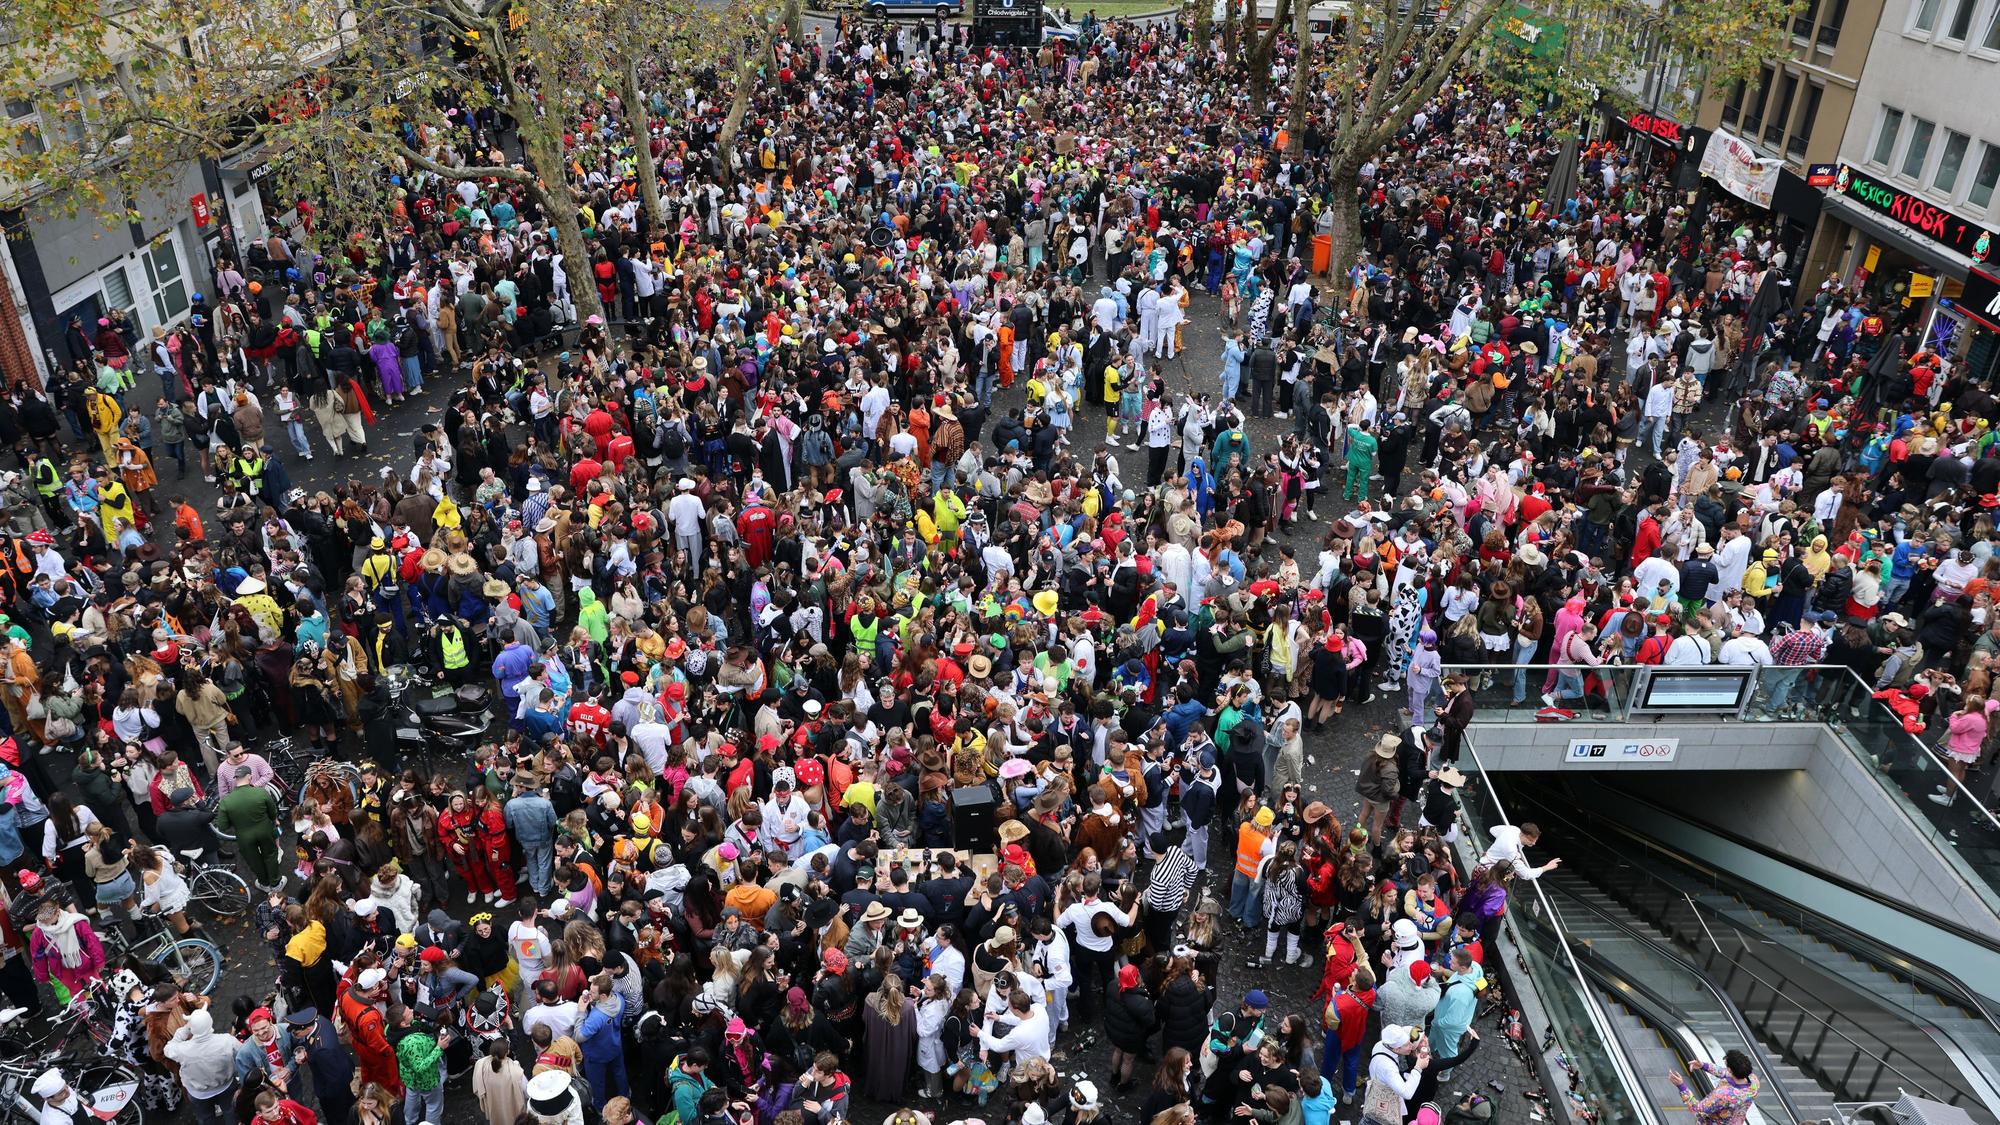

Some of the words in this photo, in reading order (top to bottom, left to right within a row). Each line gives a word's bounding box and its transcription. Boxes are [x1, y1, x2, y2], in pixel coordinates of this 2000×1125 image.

[1816, 167, 1831, 176] sky
[422, 206, 432, 216] 12
[1851, 178, 1893, 208] MEXICO
[1890, 194, 1950, 239] KIOSK
[574, 720, 600, 739] 87
[1575, 745, 1588, 756] U
[1592, 746, 1603, 755] 17
[267, 1051, 282, 1063] EW
[100, 1094, 116, 1102] KVB
